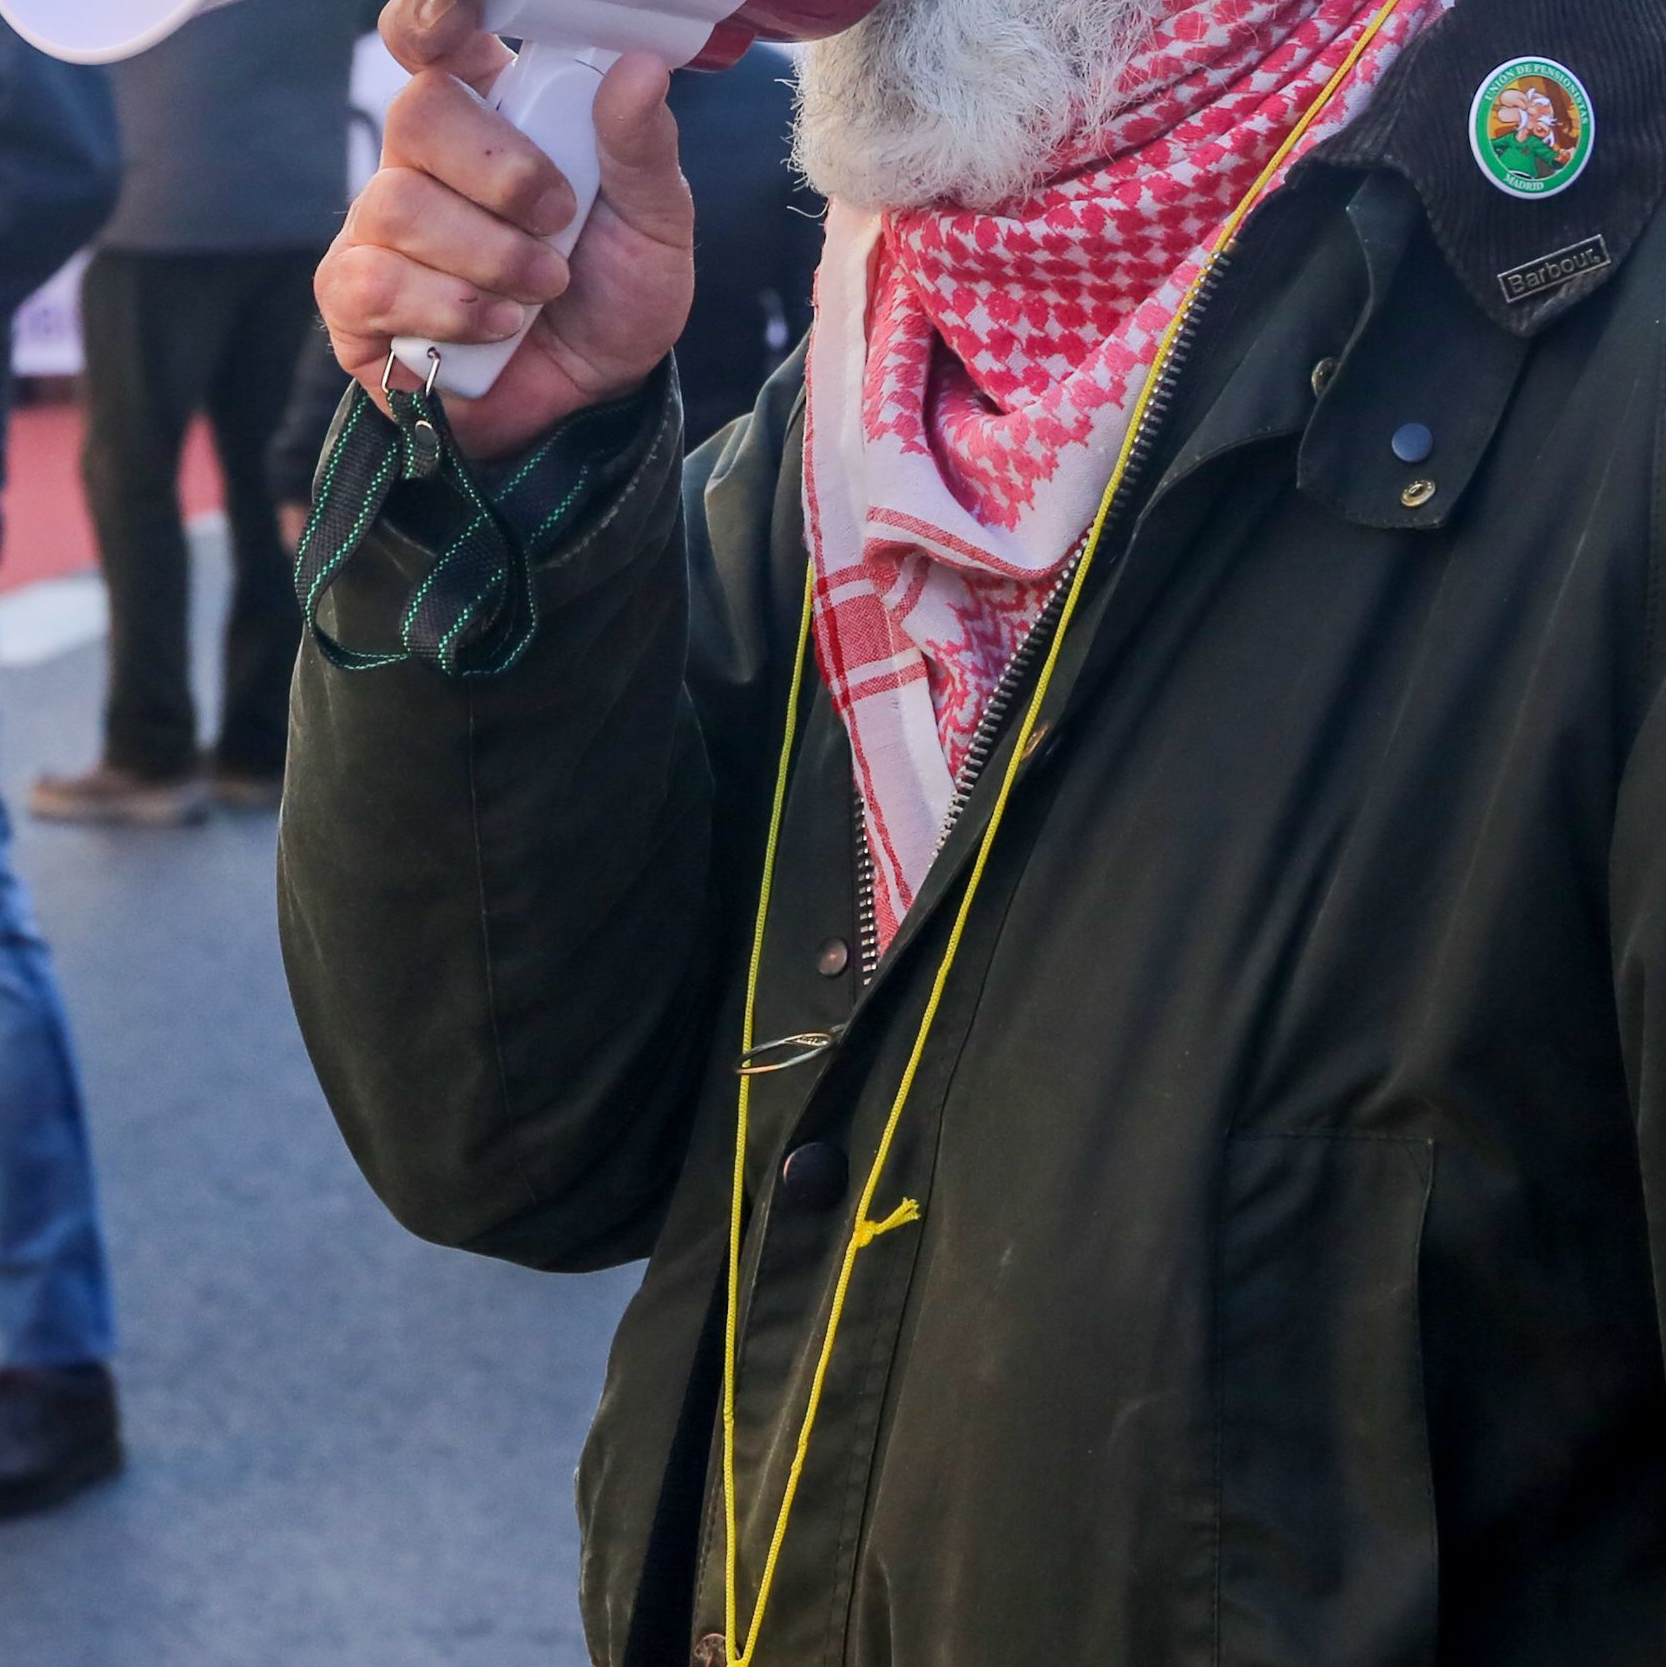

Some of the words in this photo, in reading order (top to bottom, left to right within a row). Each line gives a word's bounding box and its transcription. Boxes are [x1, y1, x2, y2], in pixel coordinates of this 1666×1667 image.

[1516, 64, 1532, 74] DE
[1533, 63, 1589, 124] PENSIONISTAS
[1503, 174, 1544, 191] MADRID
